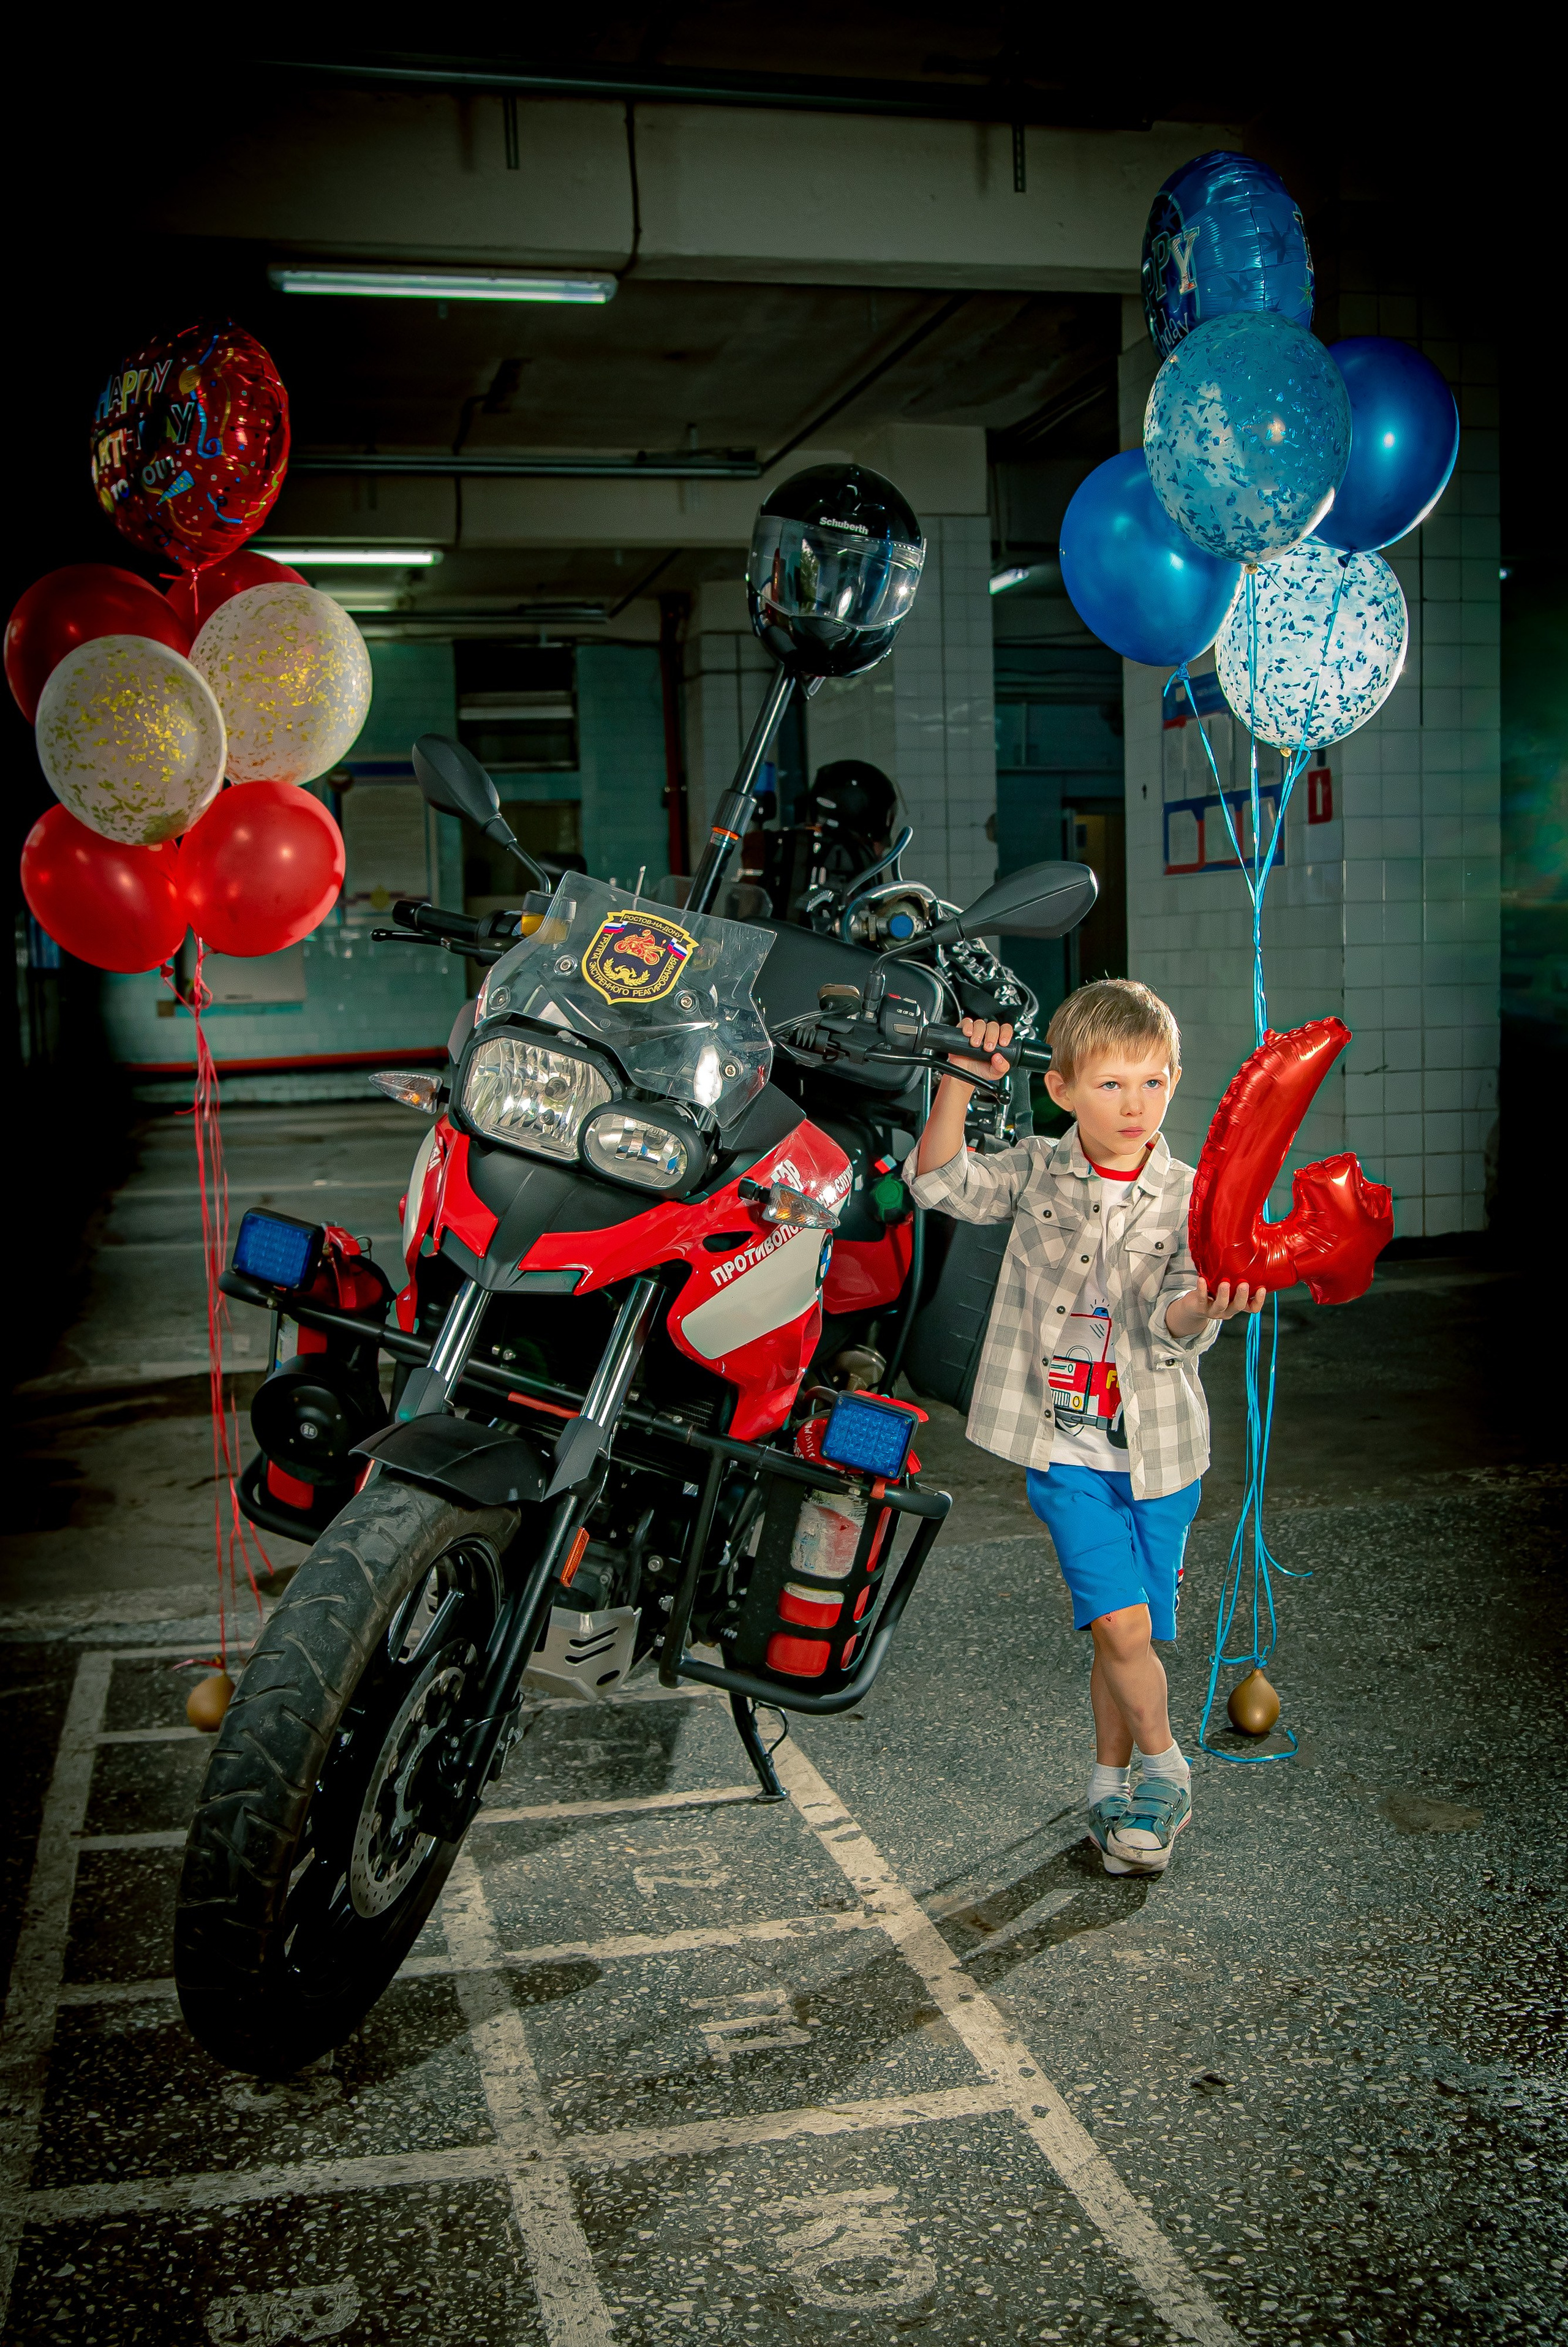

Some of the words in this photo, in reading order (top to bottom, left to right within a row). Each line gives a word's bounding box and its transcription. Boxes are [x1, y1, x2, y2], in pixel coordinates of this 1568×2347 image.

[96, 359, 174, 424] HAPPY
[819, 516, 869, 536] Schuberth
[624, 914, 683, 939] РОСТОВ-НА-ДОНУ
[590, 933, 611, 960] ГРУППА
[589, 961, 630, 996] ЭКСТРЕННОГО
[632, 957, 679, 998] РЕАГИРОВАНИЯ
